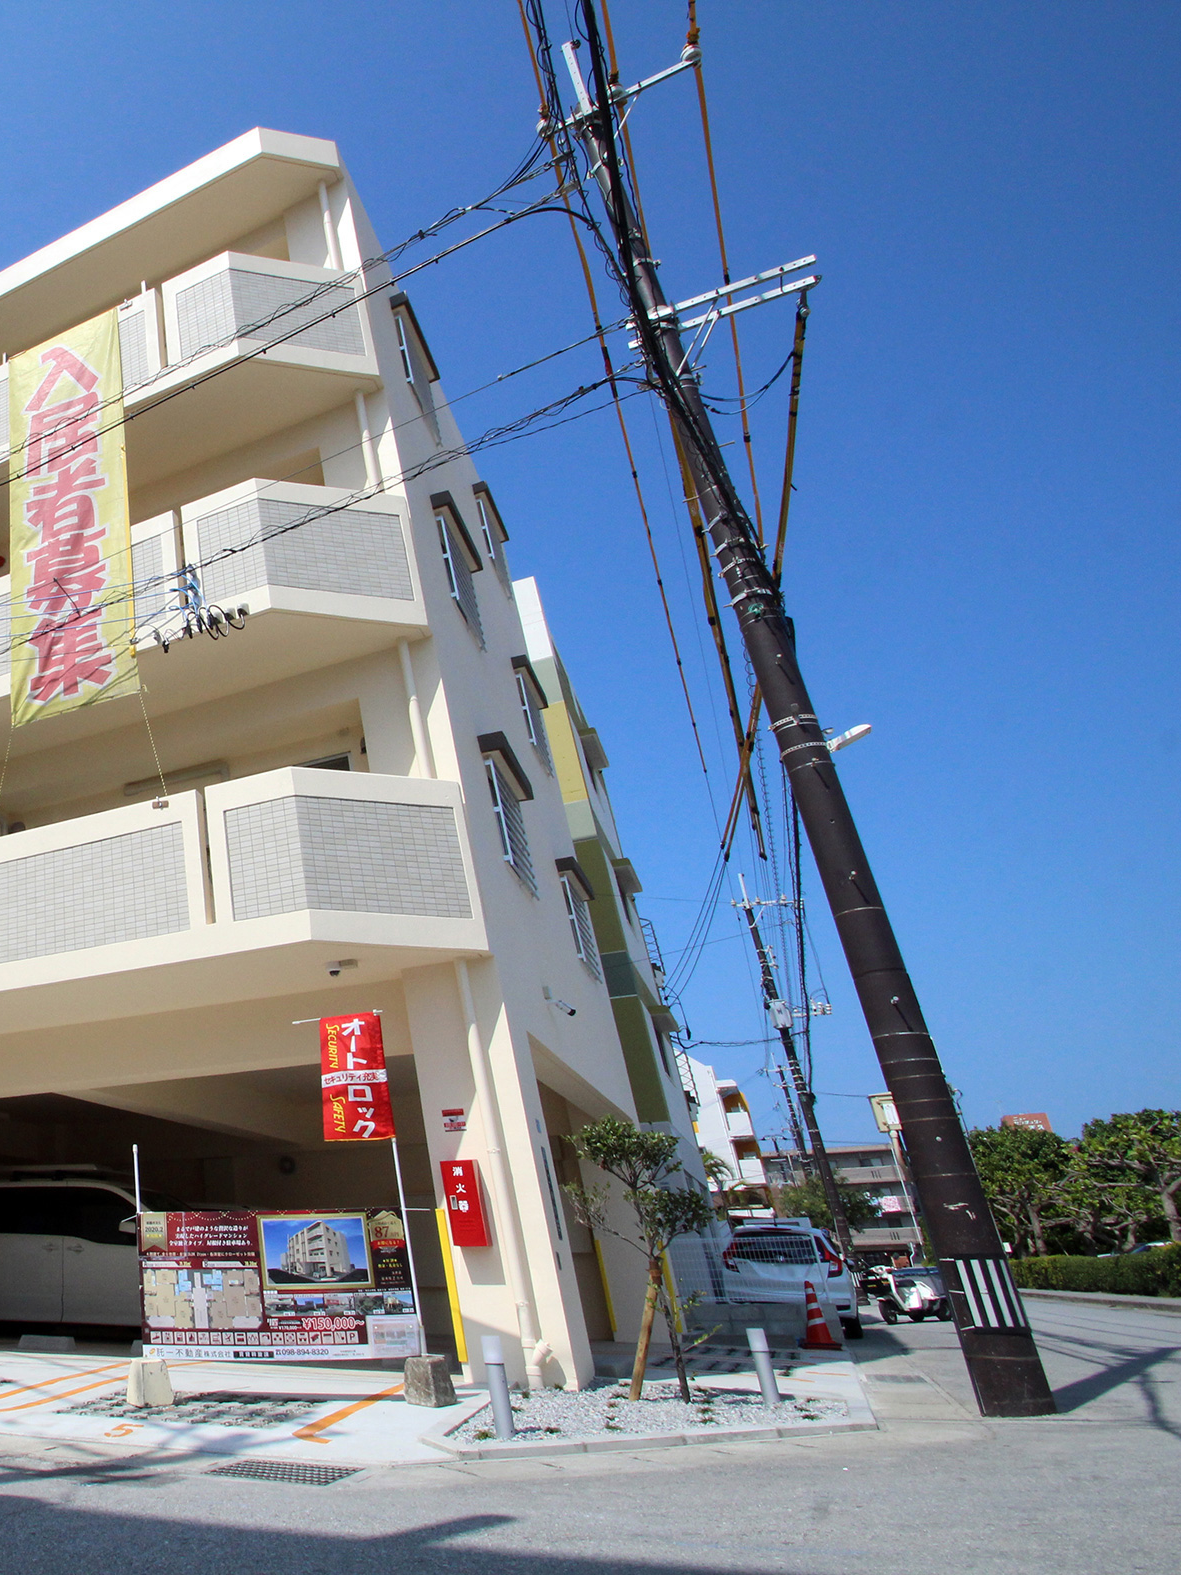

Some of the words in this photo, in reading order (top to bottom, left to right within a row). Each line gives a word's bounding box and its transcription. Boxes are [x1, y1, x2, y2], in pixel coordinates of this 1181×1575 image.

[24, 345, 115, 702] 入居者募集
[326, 1024, 340, 1069] SECURITY
[324, 1072, 379, 1084] セキュリティ充実
[341, 1018, 376, 1138] オートロック
[330, 1094, 346, 1133] SAFETY
[452, 1166, 469, 1212] 消火器
[374, 1226, 389, 1238] 87
[156, 1348, 231, 1358] 託一不動産株式会社
[281, 1348, 329, 1356] 098-894-8320
[104, 1423, 144, 1437] 5
